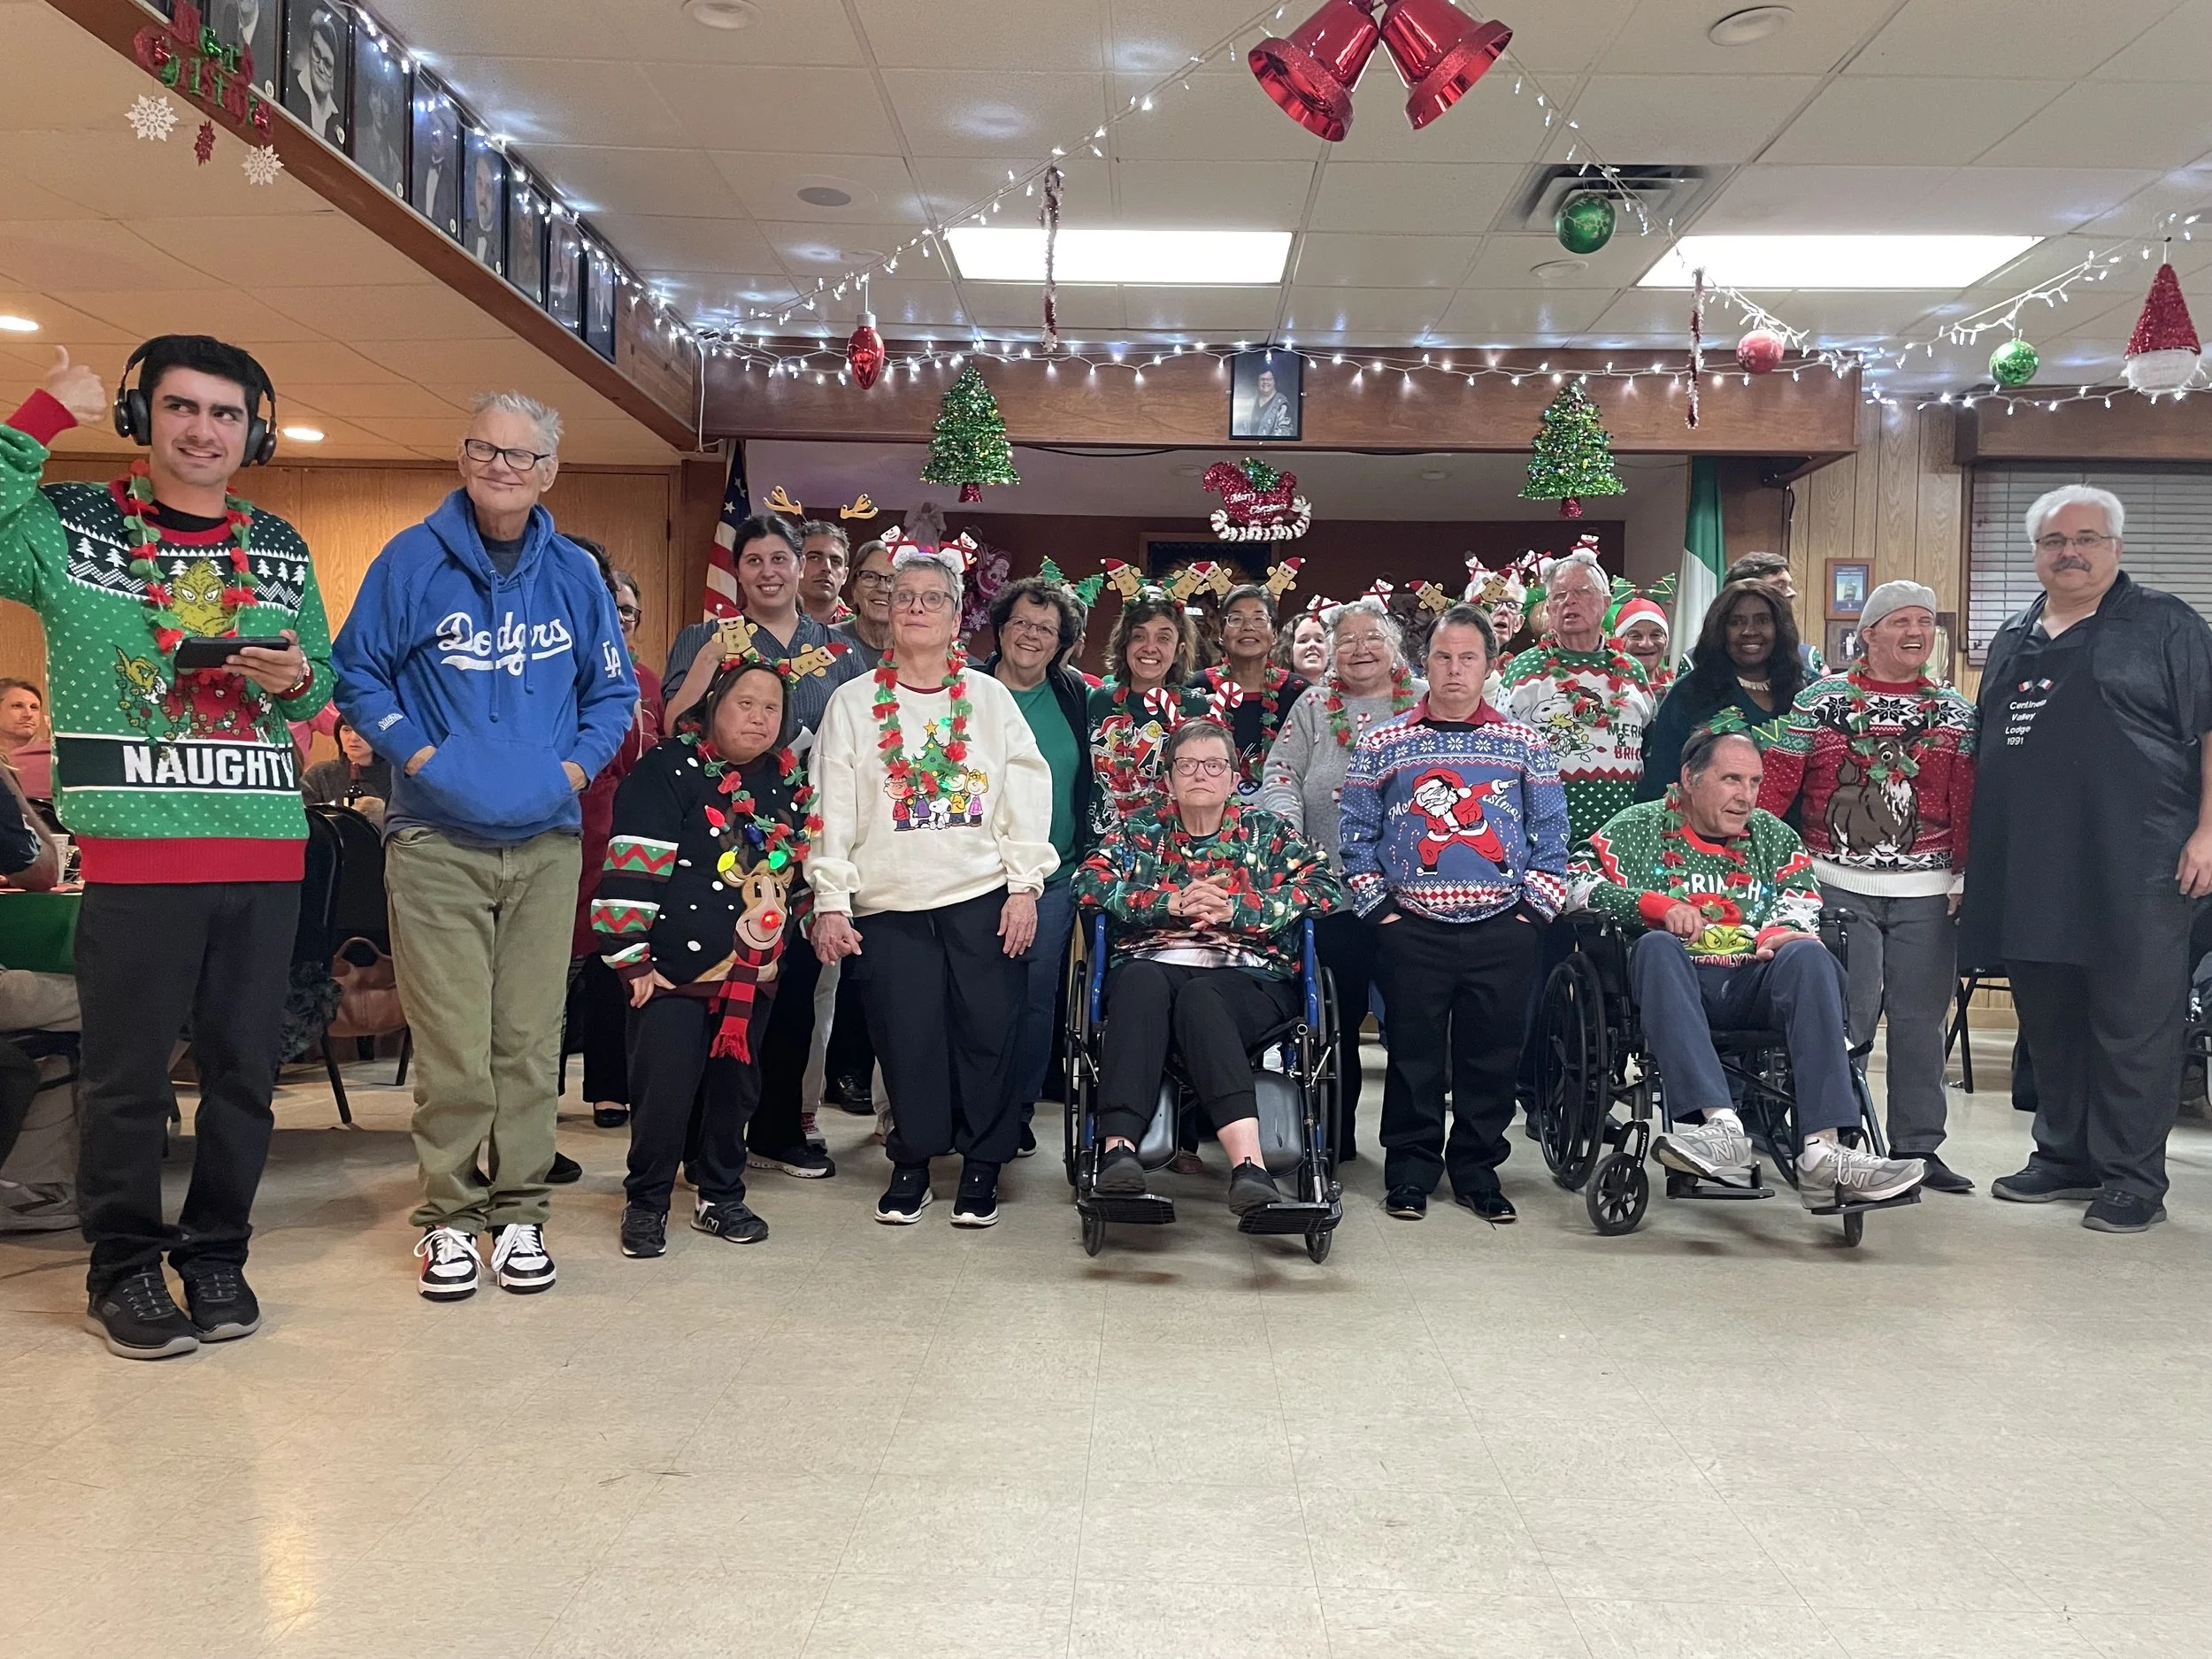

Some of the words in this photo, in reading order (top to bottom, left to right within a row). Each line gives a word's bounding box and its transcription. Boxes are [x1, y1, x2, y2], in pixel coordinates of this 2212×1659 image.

[431, 611, 572, 676] Dodgrs
[603, 641, 622, 679] LA
[1617, 733, 1626, 747] &
[2005, 726, 2032, 735] Lodge
[122, 745, 295, 788] NAUGHTY
